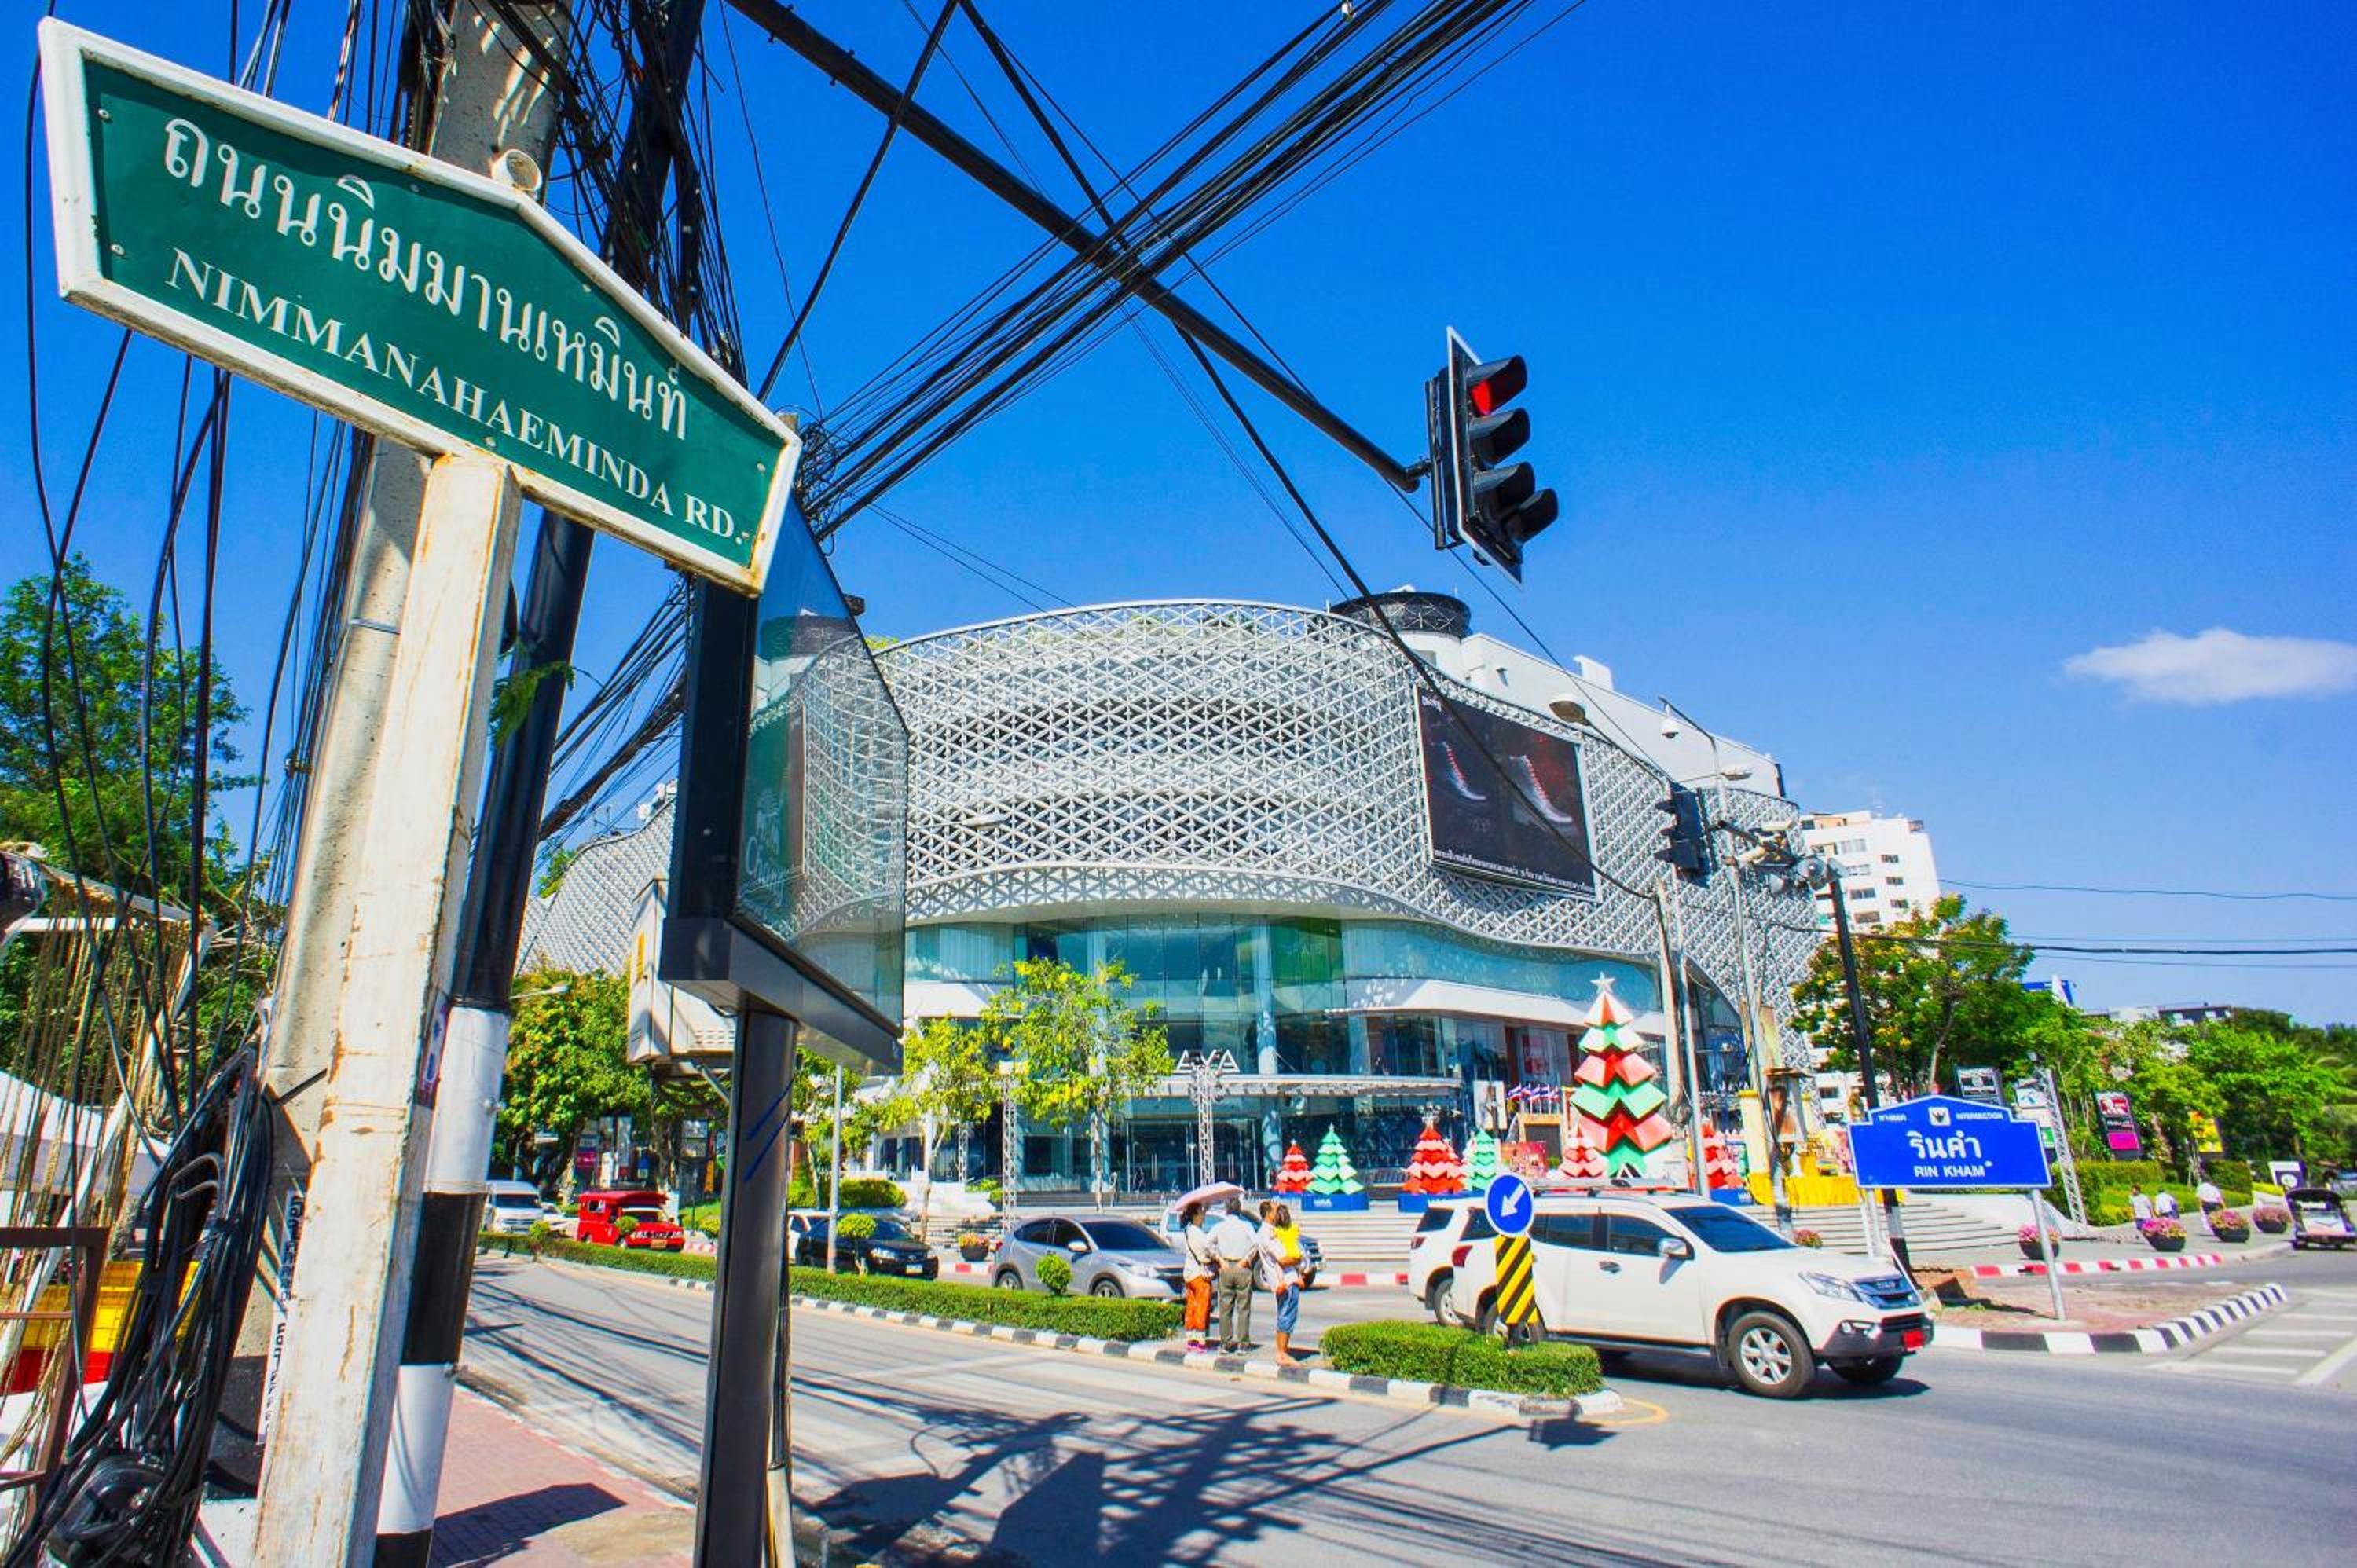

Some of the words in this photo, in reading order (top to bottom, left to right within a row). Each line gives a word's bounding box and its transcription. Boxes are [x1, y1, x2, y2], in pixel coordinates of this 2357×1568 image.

[165, 118, 687, 441] ถนนนิมมานเหมินท์
[164, 247, 674, 517] NIMMANAHAEMINDA
[684, 493, 742, 545] RD.
[1905, 1130, 1982, 1160] รินคำ
[1913, 1164, 1939, 1178] RIN
[1943, 1163, 1986, 1178] KHAM
